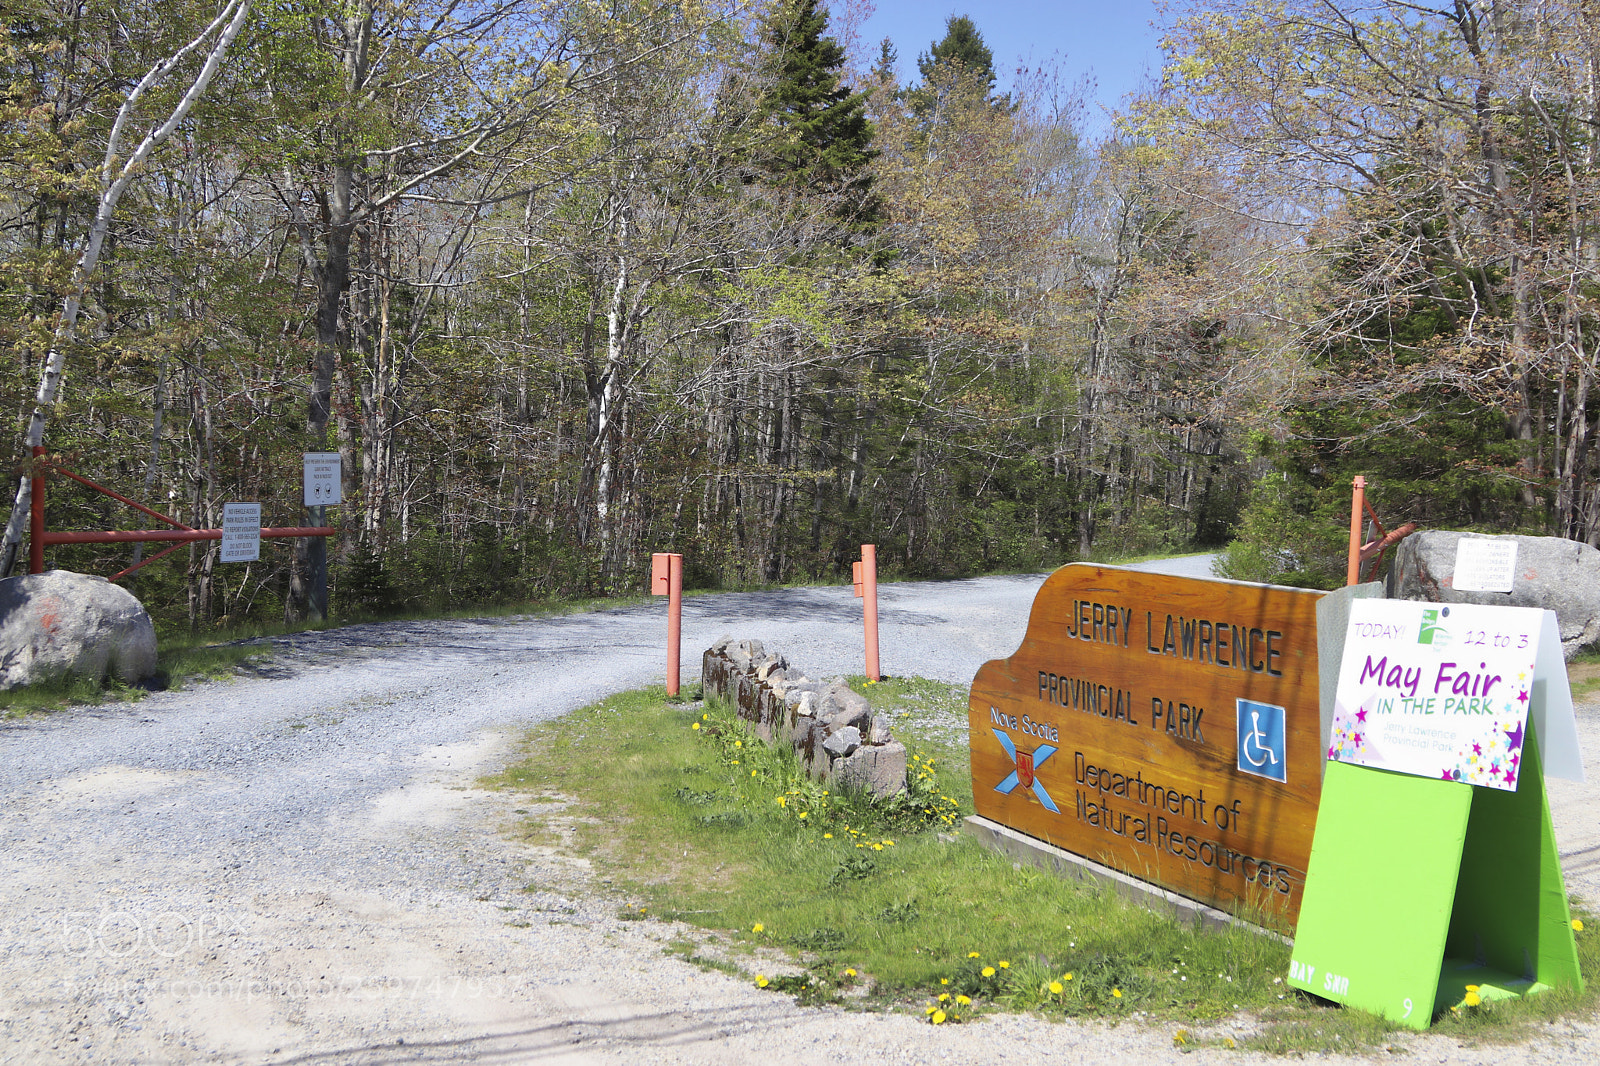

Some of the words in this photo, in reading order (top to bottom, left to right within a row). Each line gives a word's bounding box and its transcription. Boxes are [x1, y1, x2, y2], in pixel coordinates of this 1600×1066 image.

[1067, 599, 1132, 648] JERRY
[1147, 611, 1283, 677] LAWRENCE
[1355, 623, 1407, 640] TODAY!
[1464, 631, 1486, 646] 12
[1494, 631, 1511, 648] to
[1517, 634, 1529, 649] 3
[1359, 655, 1421, 698] May
[1434, 662, 1502, 698] Fair
[1038, 671, 1138, 726] PROVINCIAL
[1152, 697, 1205, 744] PARK
[1376, 698, 1394, 714] IN
[1401, 698, 1436, 715] THE
[1444, 698, 1493, 715] PARK
[990, 705, 1018, 732] Nova
[1022, 714, 1059, 743] Scotia
[1384, 721, 1406, 734] Jerry
[1408, 725, 1457, 740] Lawrence
[1383, 733, 1430, 749] Provincial
[1432, 740, 1454, 753] Park
[1075, 751, 1208, 825] Department
[1214, 799, 1241, 834] of
[1076, 789, 1151, 846] Natural
[1158, 816, 1291, 895] Resources
[1290, 959, 1315, 985] BAY
[1402, 997, 1413, 1019] 9
